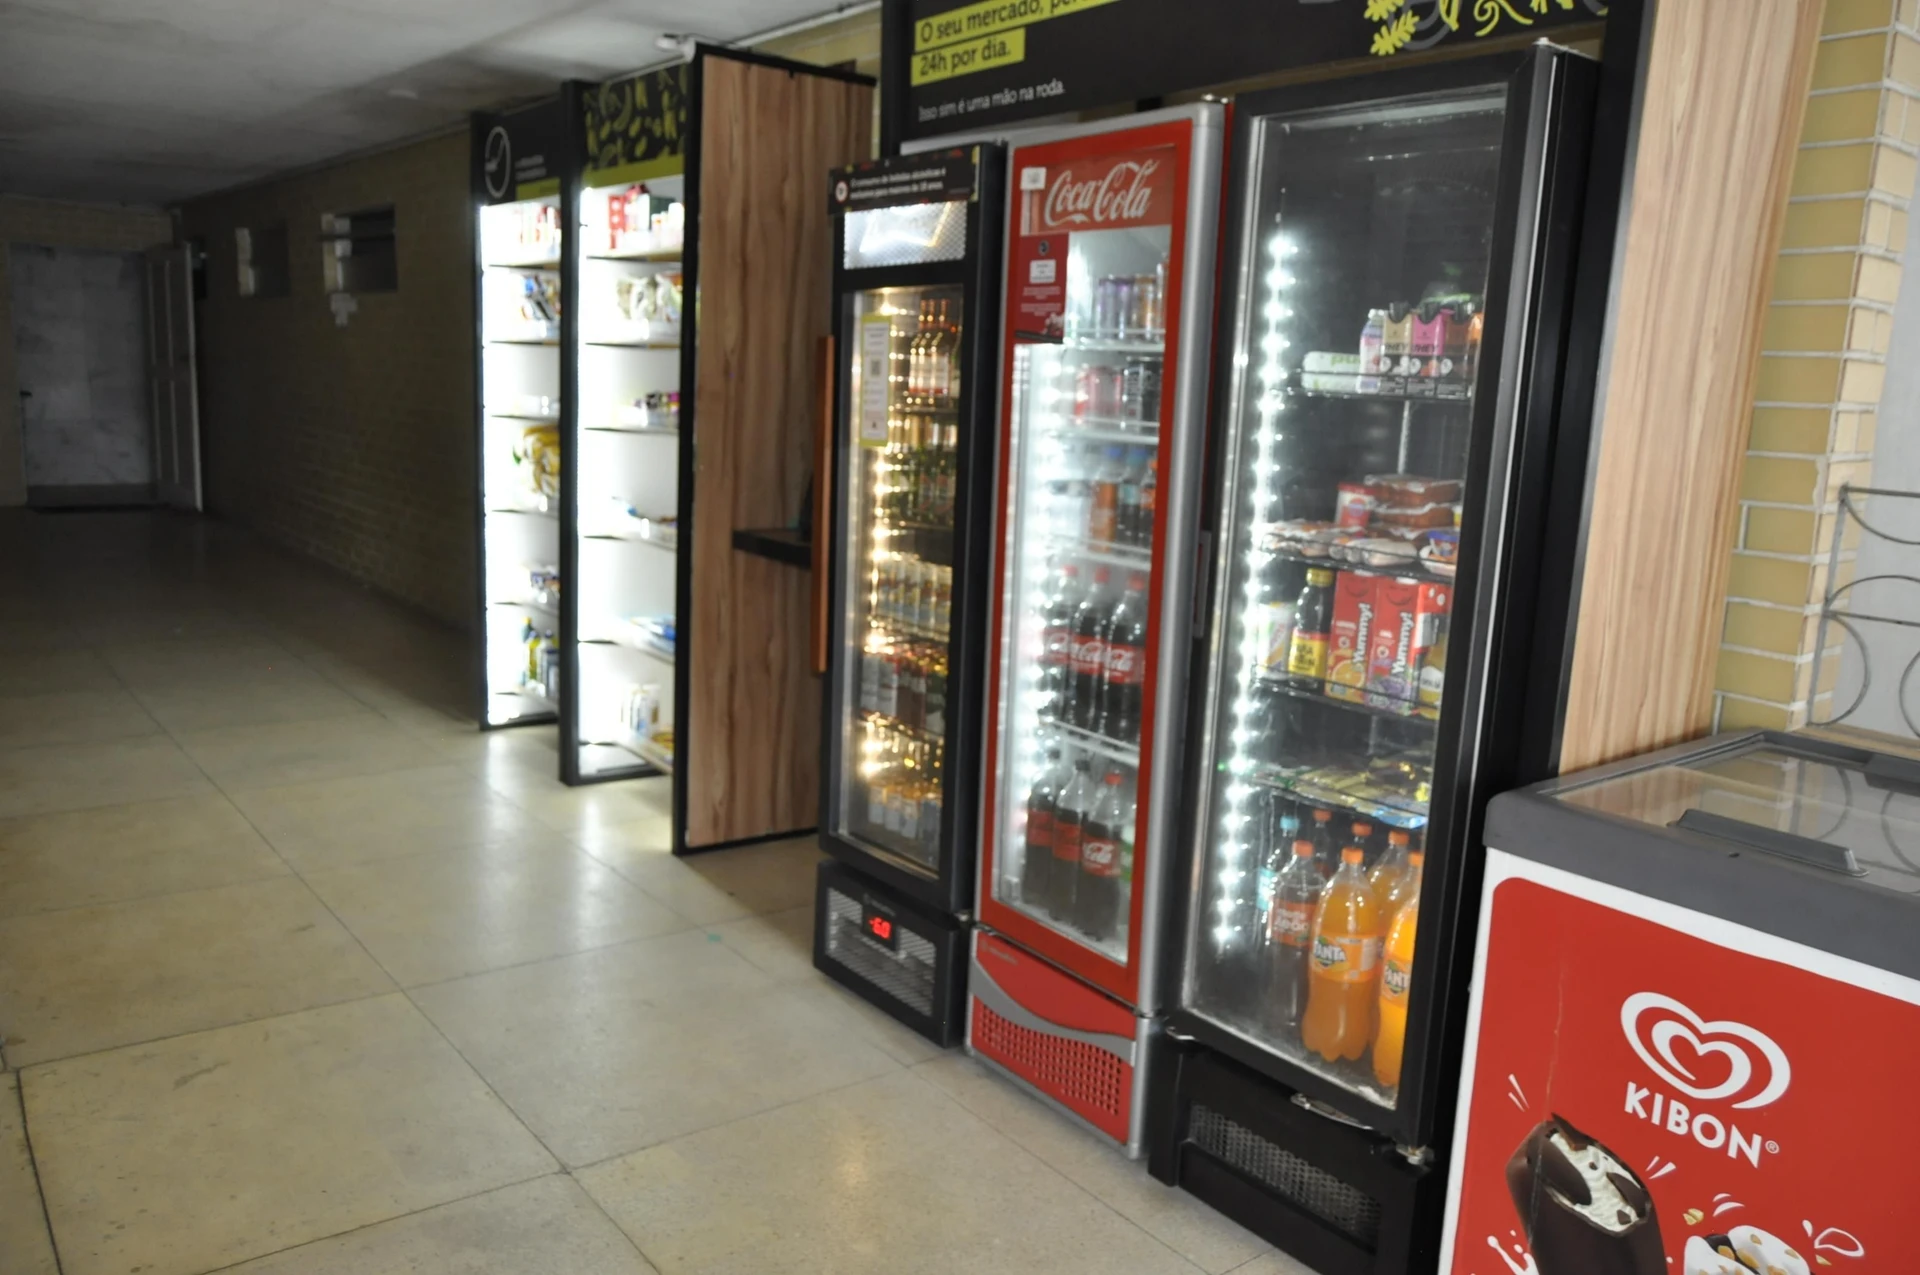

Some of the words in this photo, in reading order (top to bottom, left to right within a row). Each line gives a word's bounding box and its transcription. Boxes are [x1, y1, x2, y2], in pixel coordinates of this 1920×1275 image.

[921, 22, 933, 43] O
[937, 19, 962, 39] seu
[967, 0, 1043, 30] mercado,
[920, 52, 947, 76] 24h
[951, 48, 977, 72] por
[982, 40, 1011, 60] dia.
[967, 96, 990, 112] uma
[992, 88, 1017, 106] mão
[1019, 86, 1034, 101] na
[1624, 1081, 1762, 1168] KIBON
